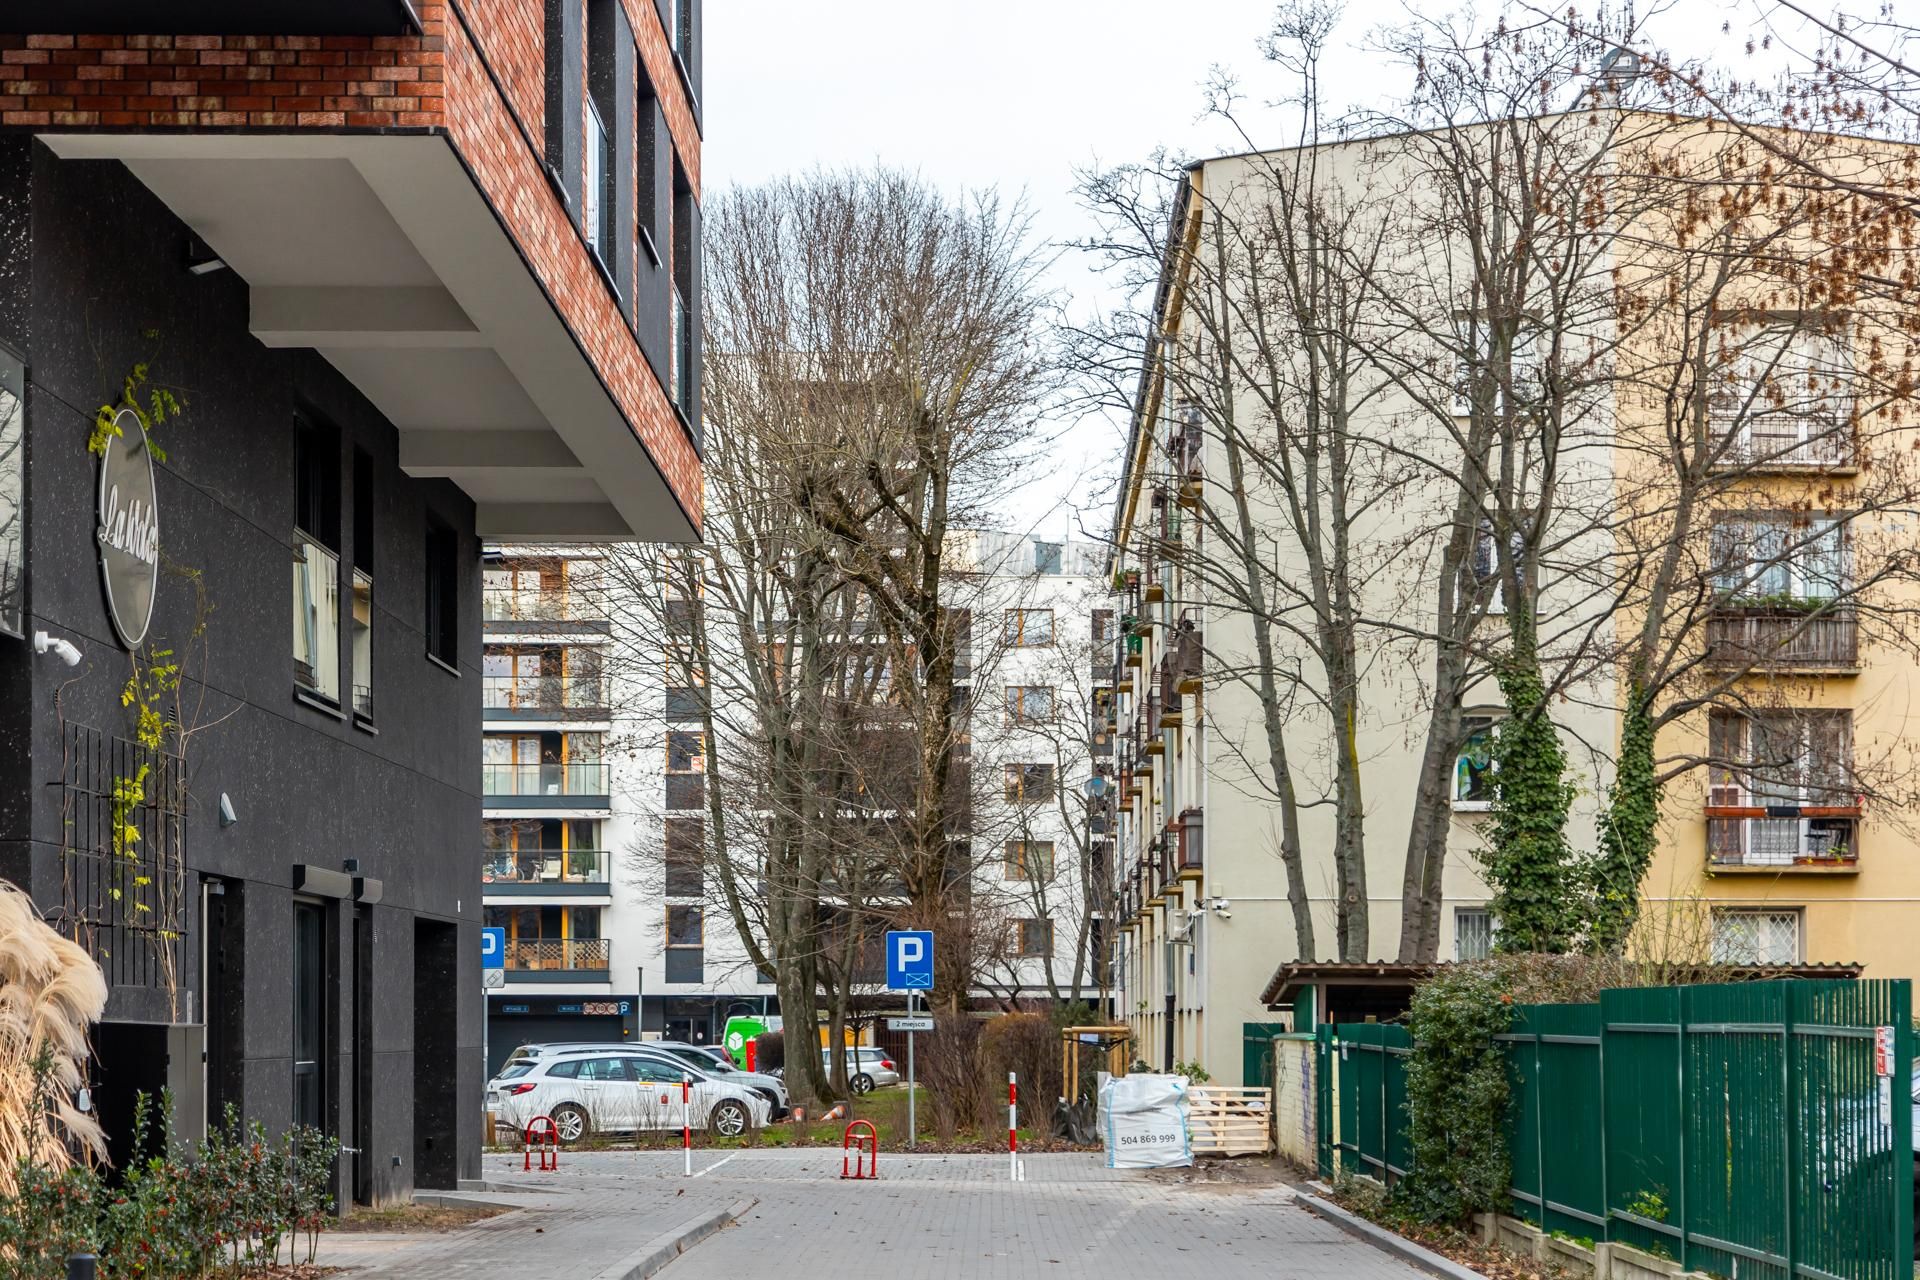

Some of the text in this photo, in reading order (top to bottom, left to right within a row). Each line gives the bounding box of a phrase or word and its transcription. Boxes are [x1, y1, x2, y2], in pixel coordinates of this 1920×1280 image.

[898, 937, 924, 972] P
[902, 1021, 926, 1029] miejsca
[1121, 1134, 1176, 1145] 504 869 999
